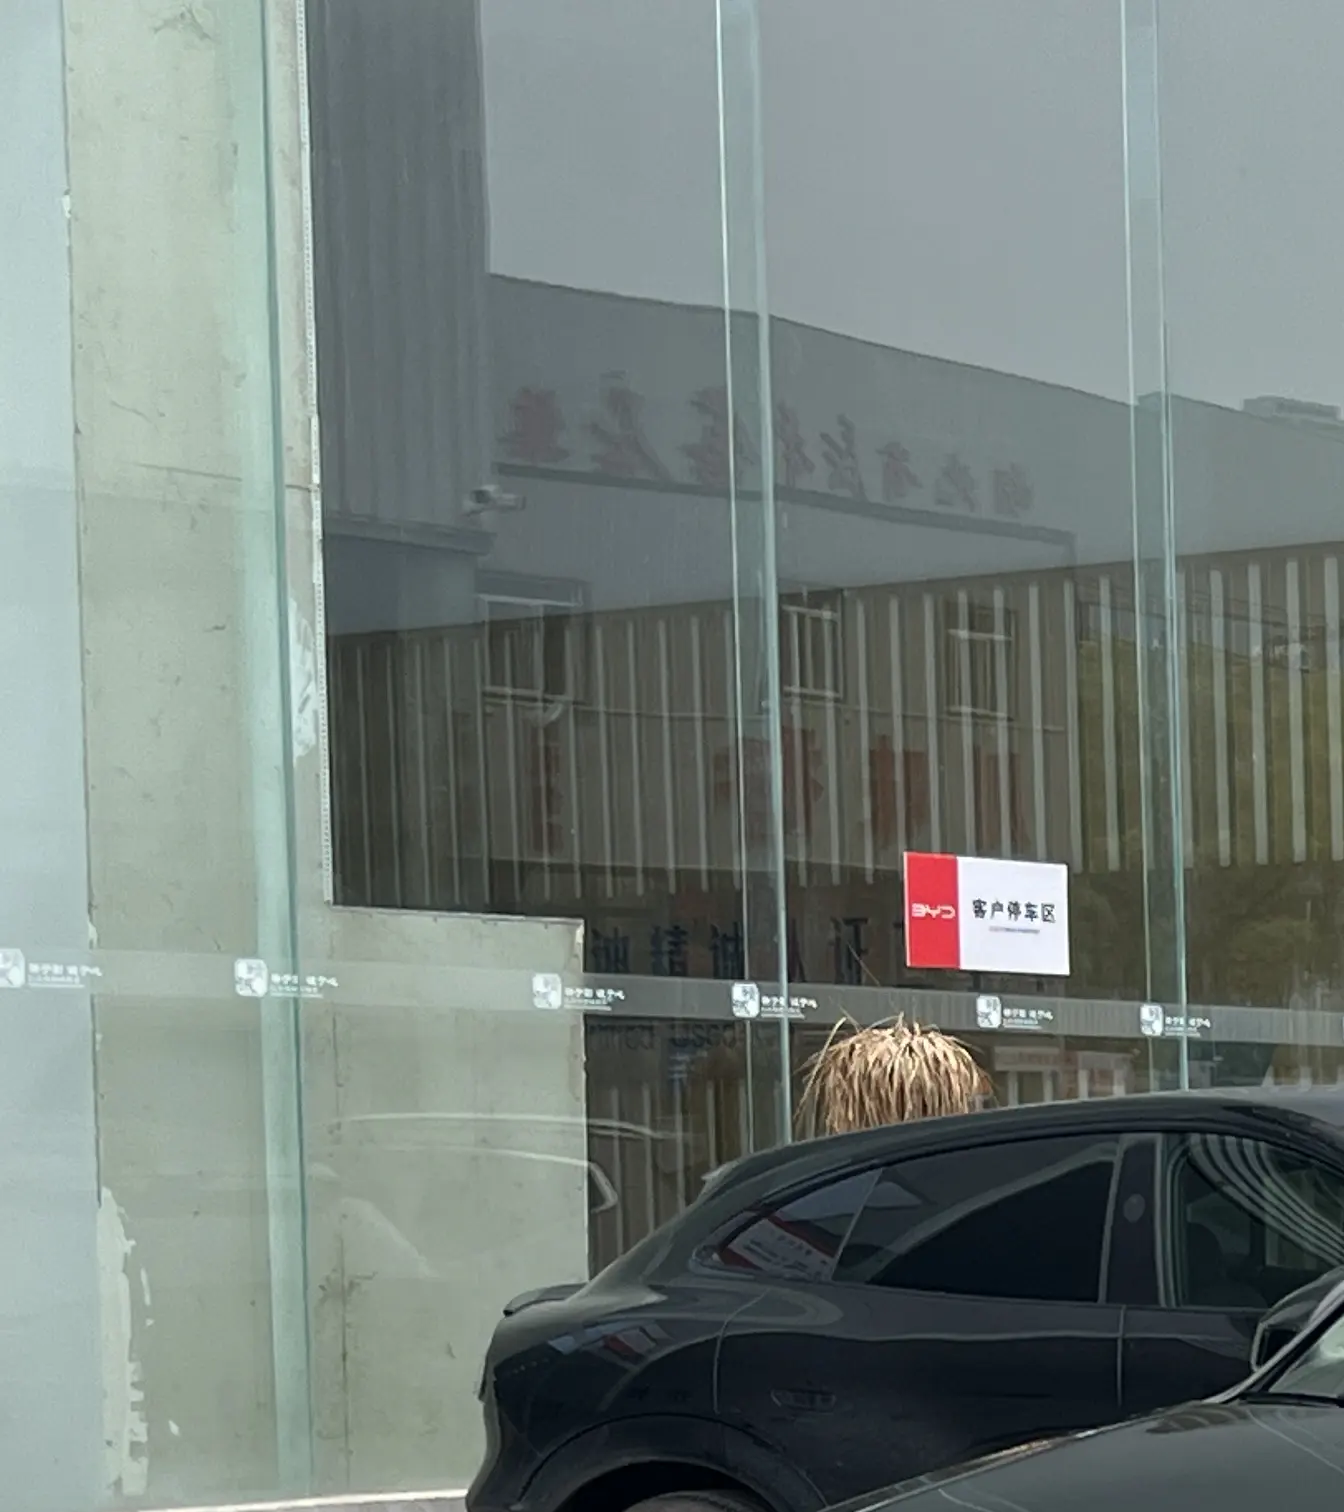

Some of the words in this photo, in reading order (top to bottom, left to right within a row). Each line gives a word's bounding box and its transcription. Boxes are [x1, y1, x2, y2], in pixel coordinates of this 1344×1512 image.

[972, 898, 1056, 923] 客户停车区
